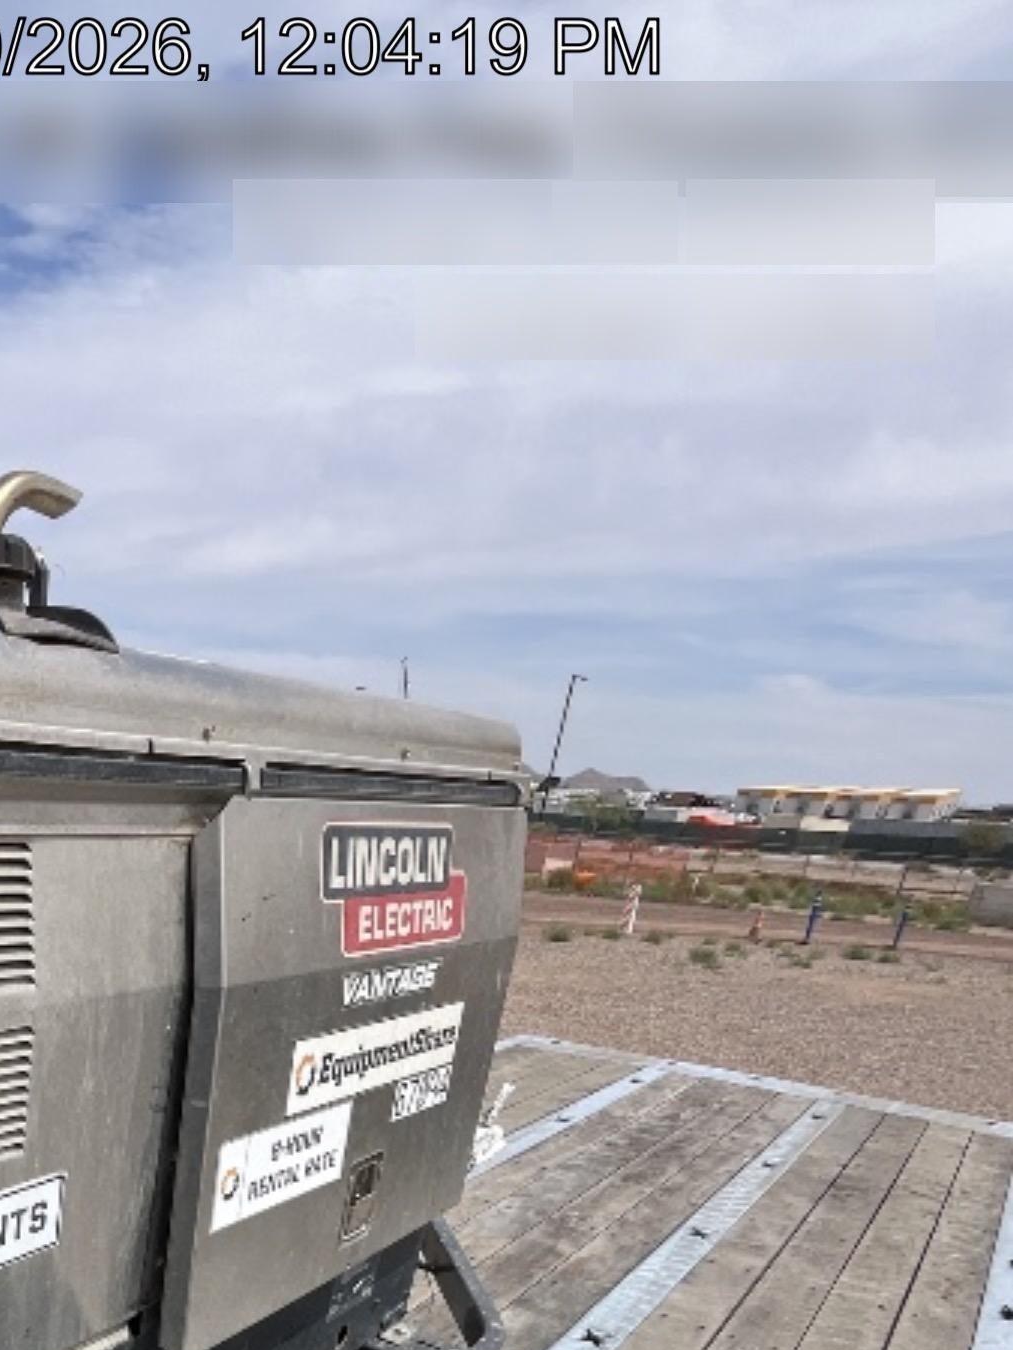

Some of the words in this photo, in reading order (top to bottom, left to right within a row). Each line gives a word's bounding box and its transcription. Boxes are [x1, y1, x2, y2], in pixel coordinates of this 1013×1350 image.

[329, 836, 448, 889] LINCOLN
[358, 897, 453, 942] ELECTRIC
[342, 957, 443, 1008] VANTAGE
[318, 1026, 456, 1086] EquipmentShare
[248, 1163, 300, 1201] RENTAL
[304, 1149, 338, 1178] RATE
